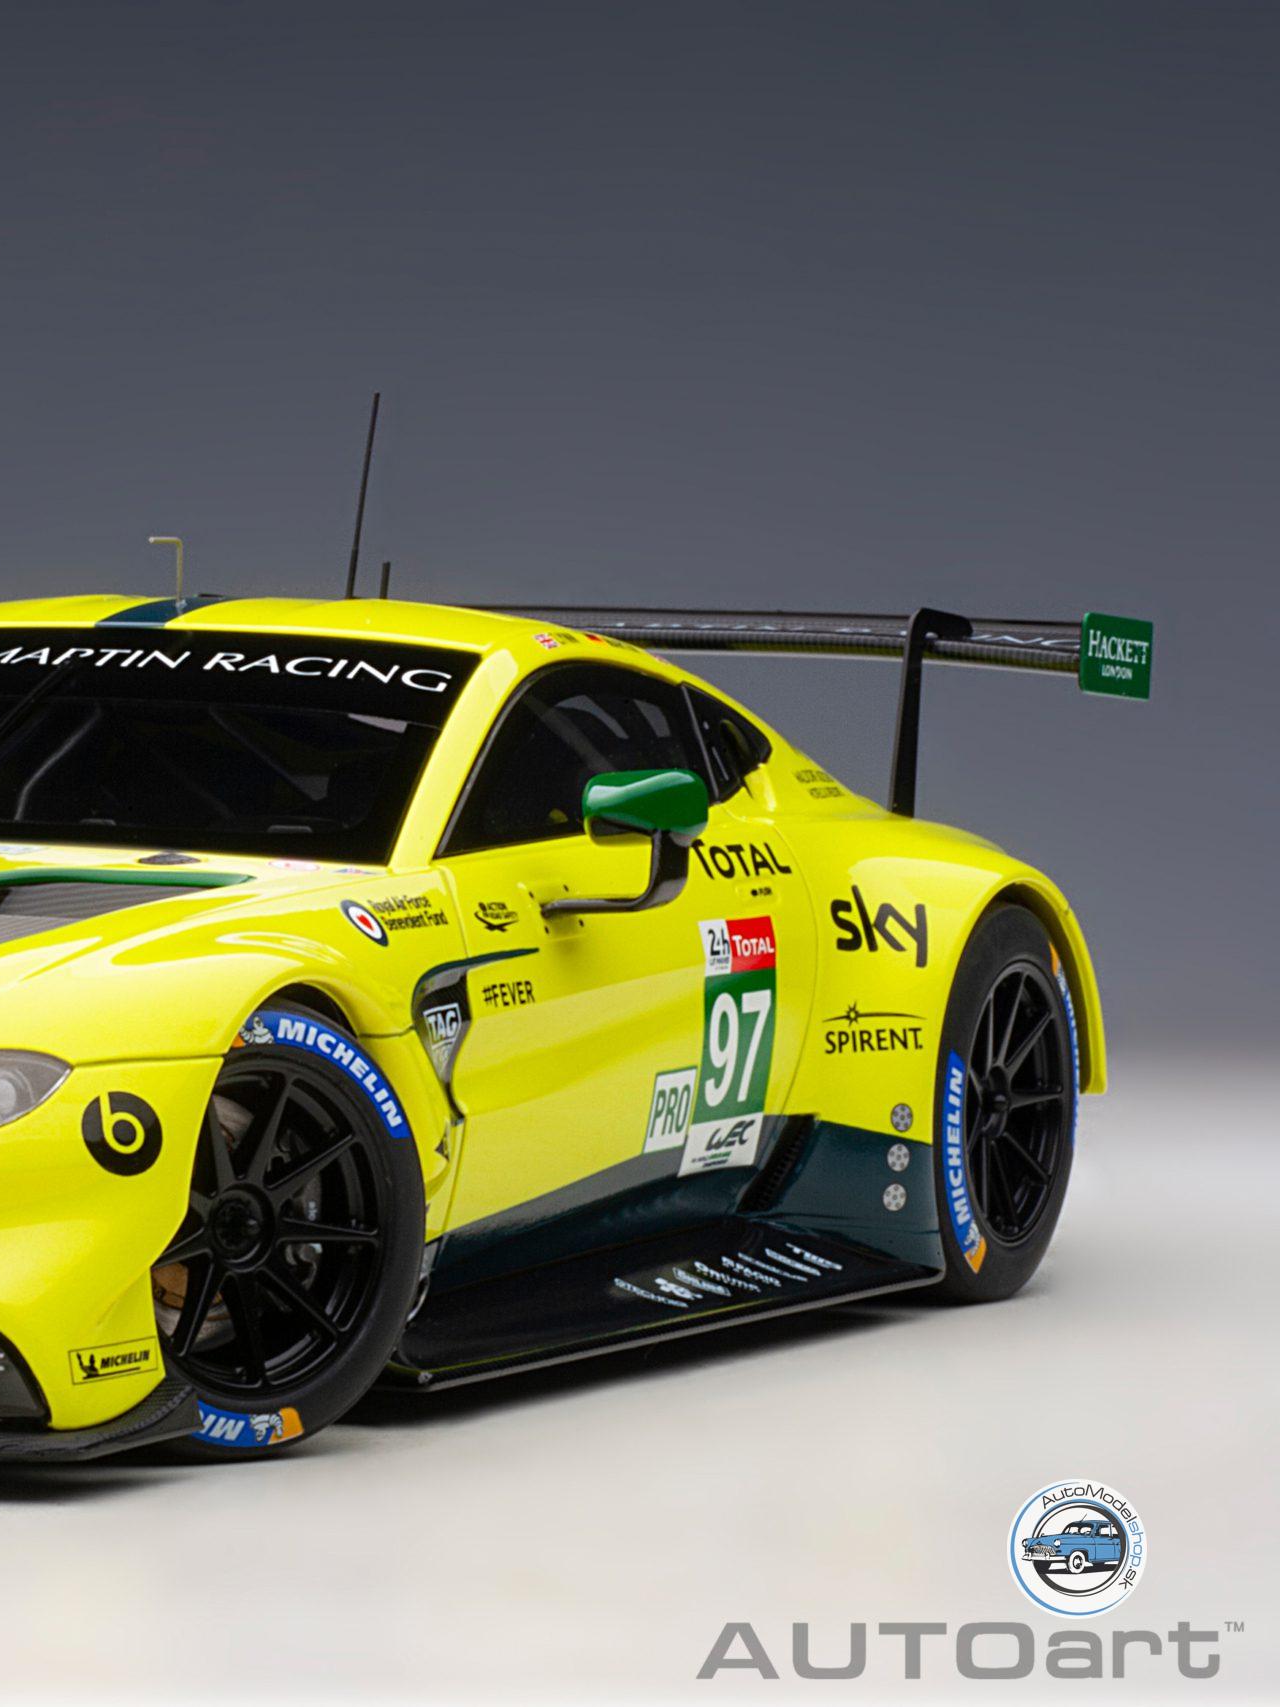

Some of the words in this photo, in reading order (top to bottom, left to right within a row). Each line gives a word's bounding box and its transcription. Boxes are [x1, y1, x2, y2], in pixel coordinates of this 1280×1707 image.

[1088, 629, 1150, 664] HACKETT
[203, 651, 452, 693] RACING
[1101, 664, 1133, 680] LONDON
[691, 839, 792, 880] TOTAL
[732, 935, 775, 957] TOTAL
[830, 884, 928, 968] sky
[481, 980, 535, 1007] #FEVER
[428, 1010, 457, 1040] TAG
[704, 989, 772, 1107] 97
[277, 1018, 403, 1128] MICHELIN
[649, 1084, 691, 1138] PRO
[945, 1067, 970, 1226] MICHELIN
[100, 1350, 150, 1369] MICHELIN
